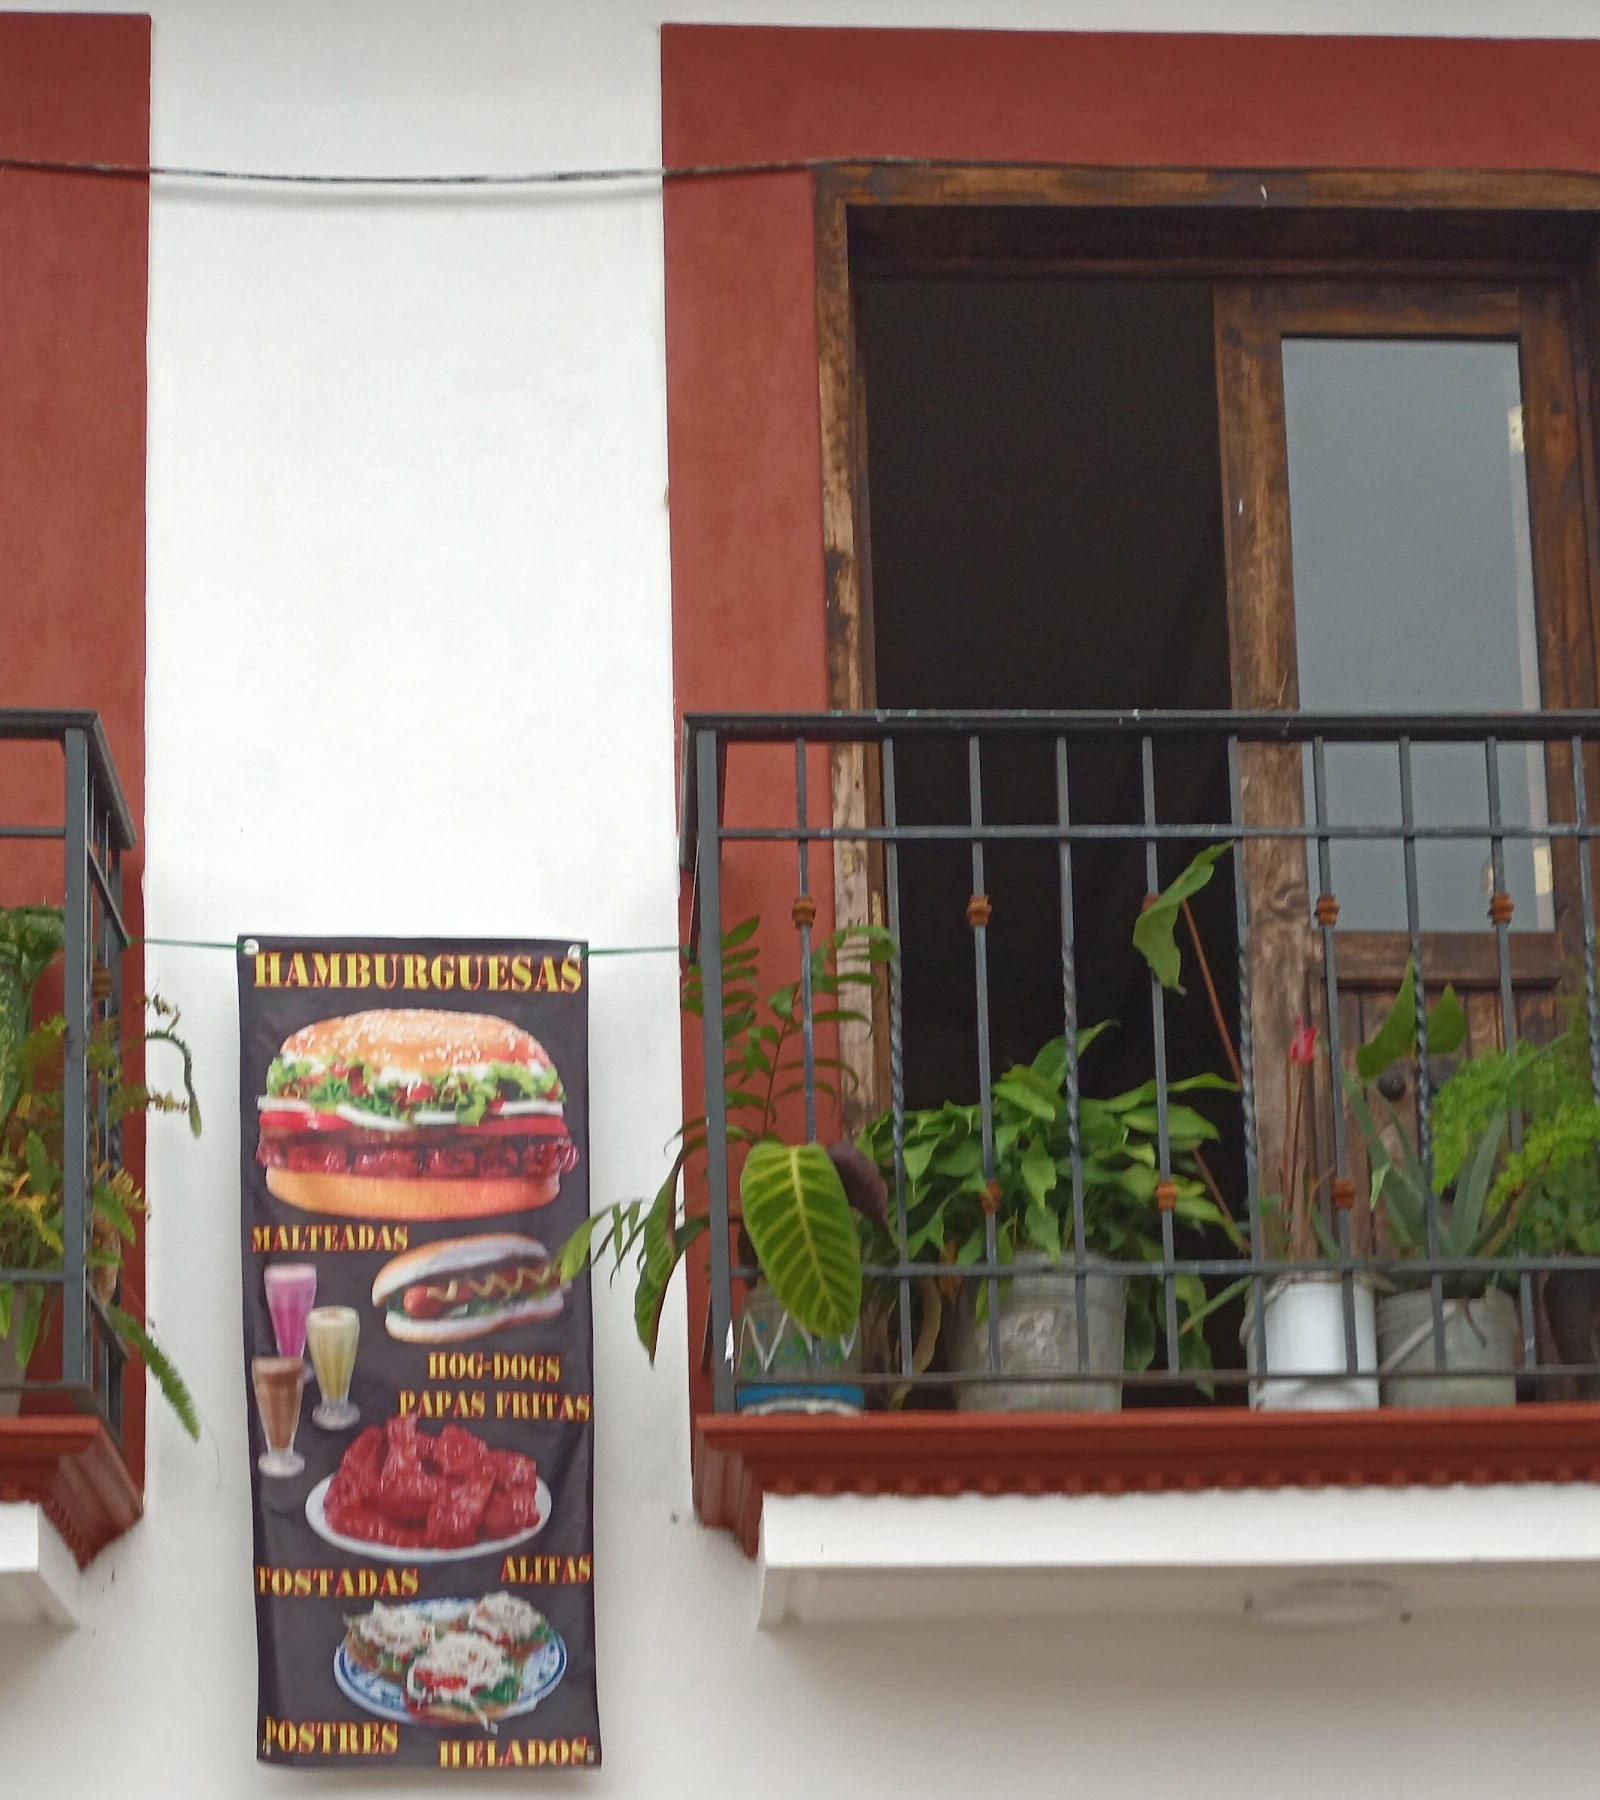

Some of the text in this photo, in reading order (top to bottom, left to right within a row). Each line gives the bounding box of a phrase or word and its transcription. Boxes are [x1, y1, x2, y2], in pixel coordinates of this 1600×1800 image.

[253, 953, 583, 993] HAMBURGUESAS
[252, 1224, 409, 1252] MALTEADAS
[428, 1352, 561, 1383] HOG-DOGS
[399, 1389, 590, 1422] PAPAS FRITAS
[257, 1564, 419, 1599] TOSTADAS
[500, 1554, 592, 1584] ALITAS
[263, 1716, 400, 1755] POSTRES
[438, 1736, 588, 1769] HELADOS
